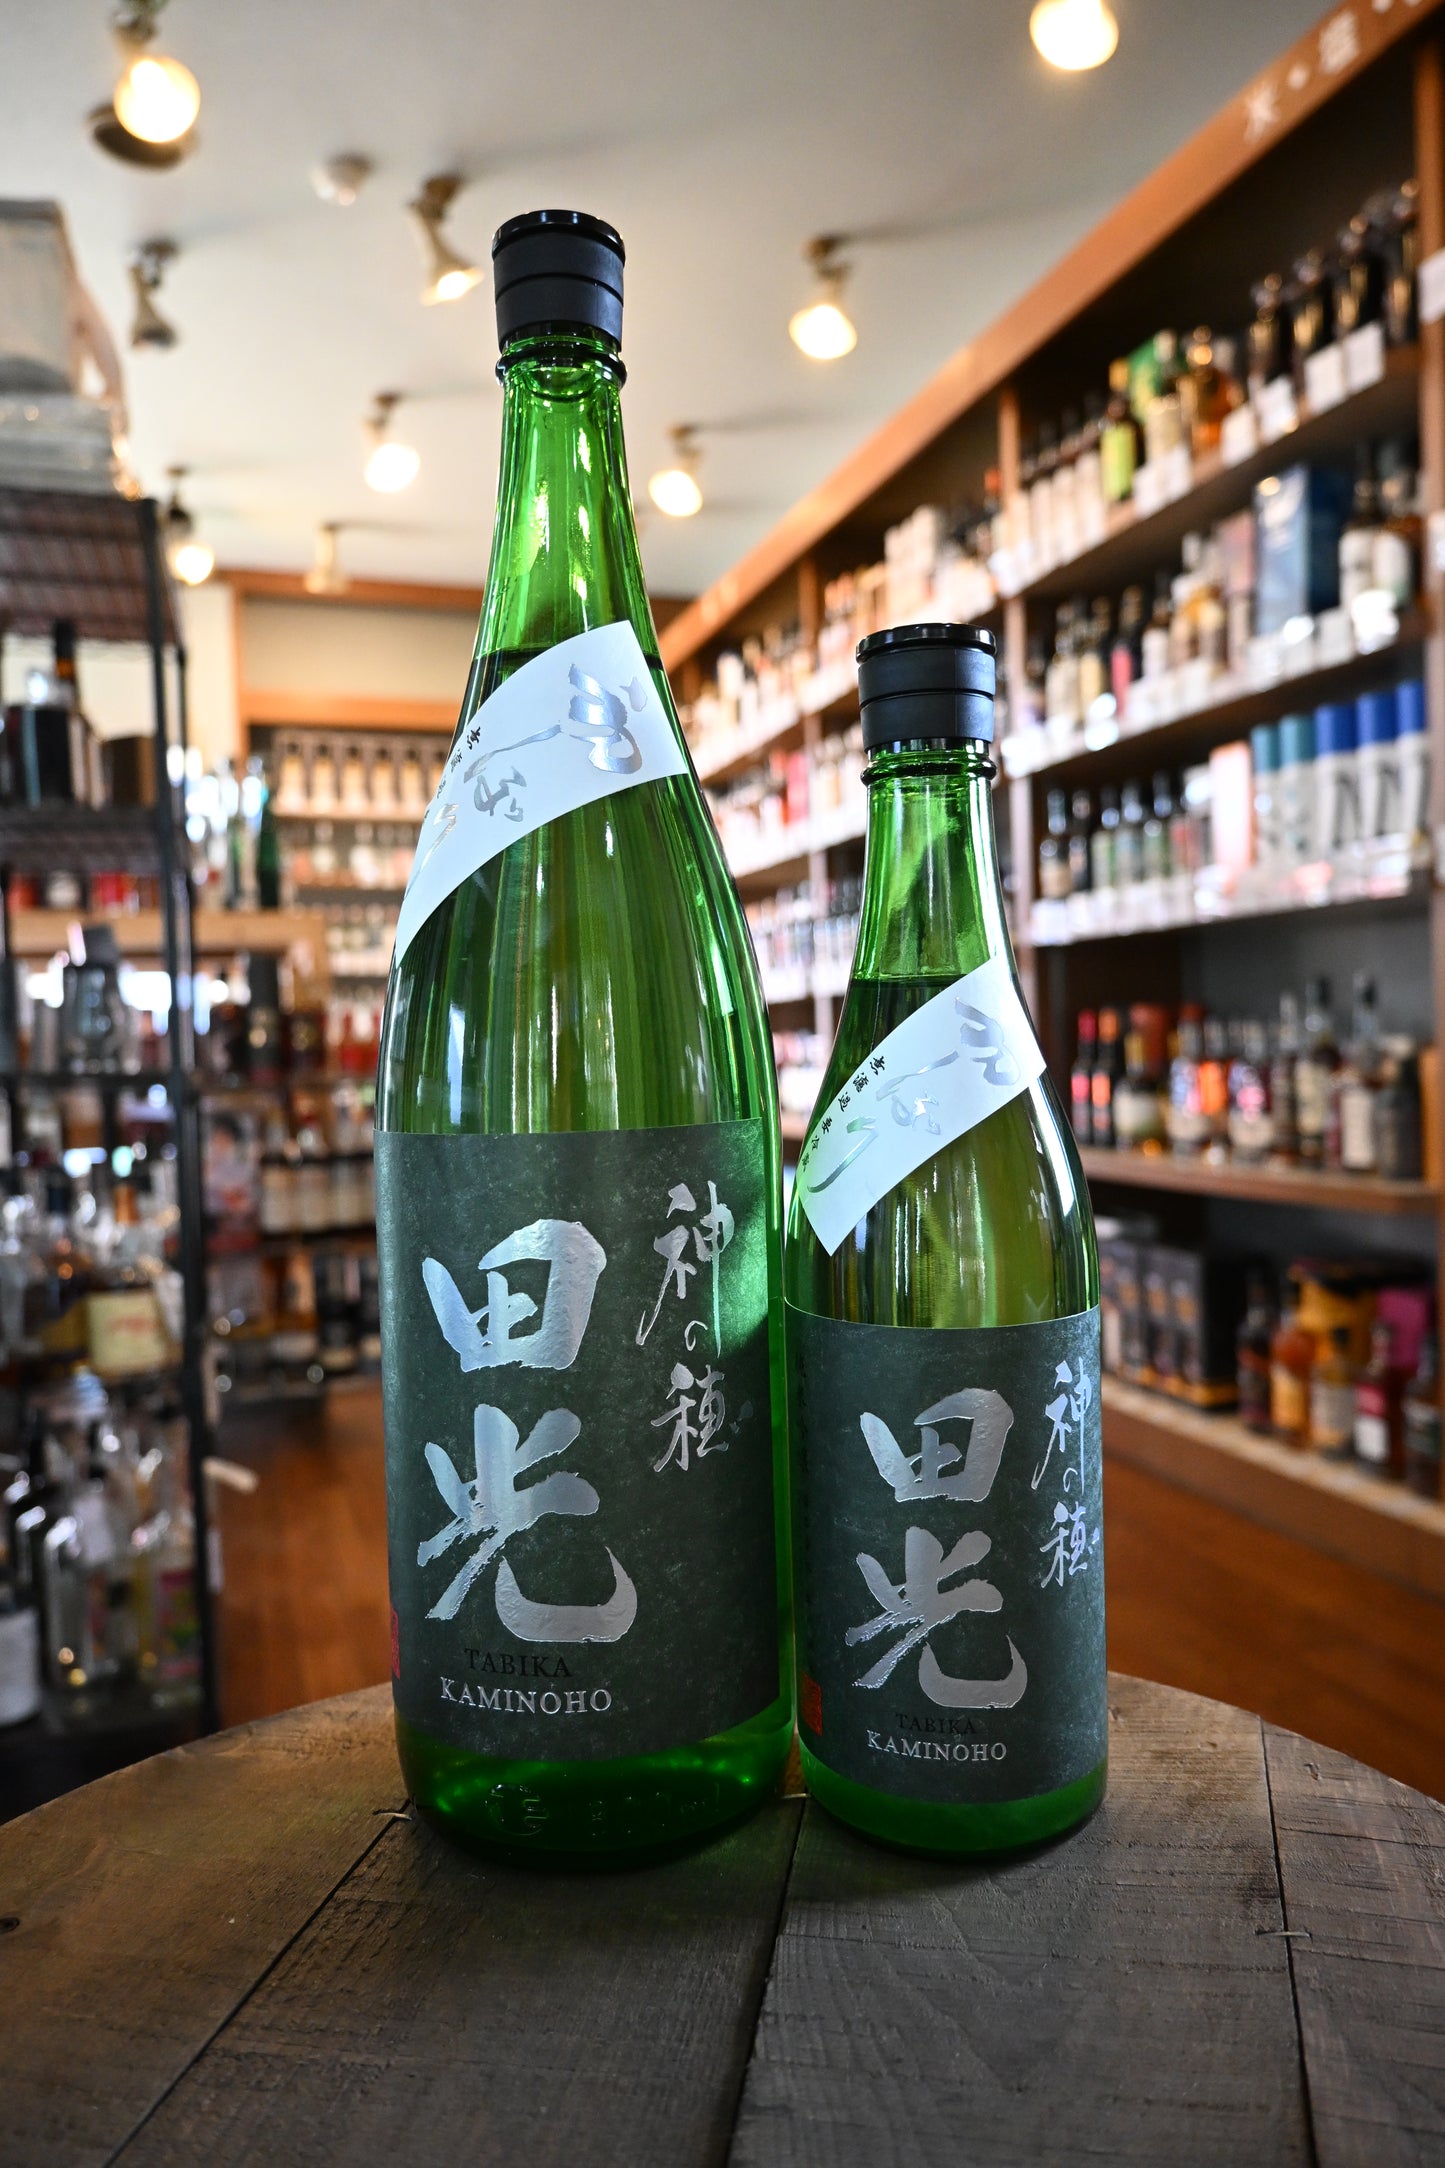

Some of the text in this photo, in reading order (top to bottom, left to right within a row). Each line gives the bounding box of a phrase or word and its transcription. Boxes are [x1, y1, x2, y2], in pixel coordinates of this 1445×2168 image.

[636, 1180, 753, 1474] 神の穂
[417, 1218, 638, 1644] 田光
[1031, 1356, 1102, 1590] 神の穂
[845, 1387, 1029, 1710] 田光
[439, 1677, 613, 1715] KAMINOHO
[464, 1647, 572, 1679] TABIKA
[894, 1712, 978, 1735] TABIKA
[867, 1730, 1008, 1762] KAMINOHO
